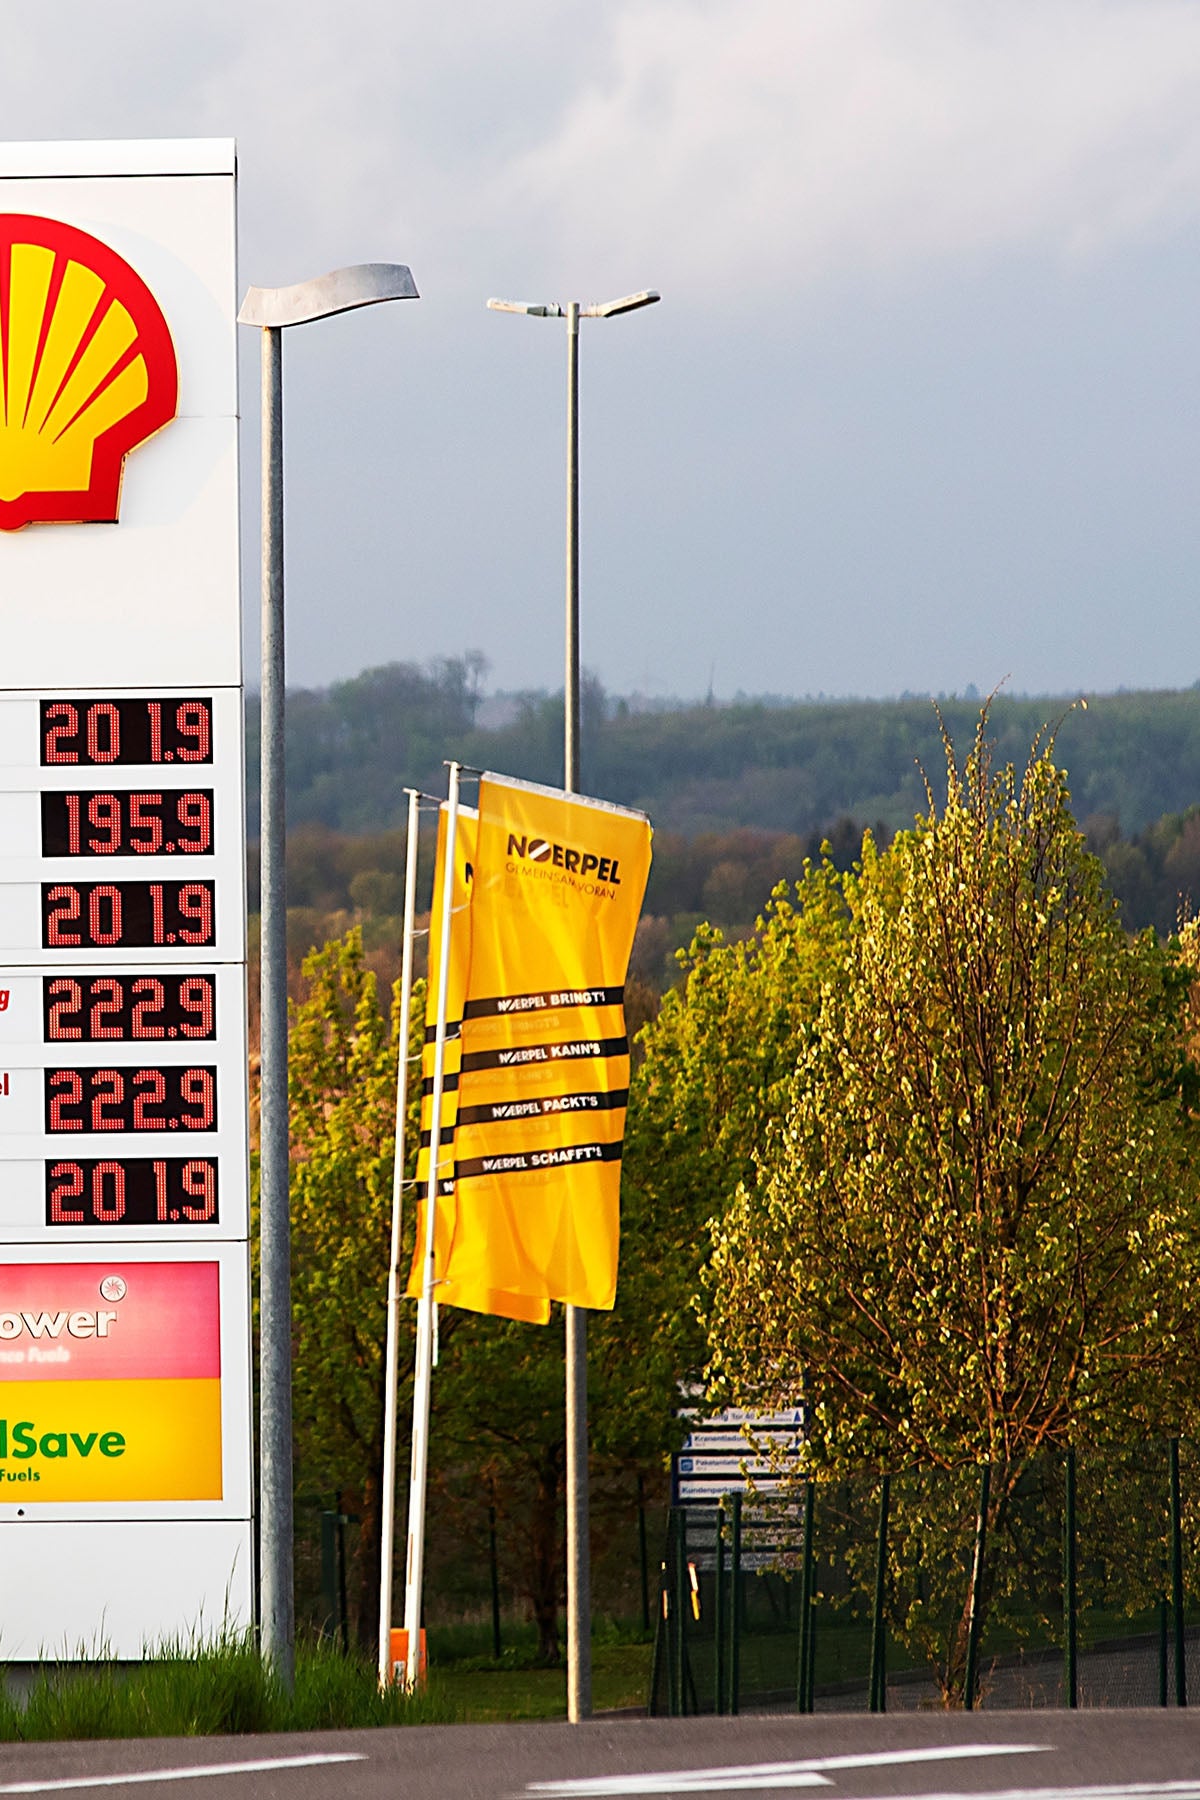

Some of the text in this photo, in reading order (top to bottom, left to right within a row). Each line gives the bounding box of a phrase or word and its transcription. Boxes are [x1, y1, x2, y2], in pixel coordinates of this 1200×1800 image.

[45, 702, 209, 763] 201.9
[65, 793, 211, 854] 195.9
[47, 884, 212, 946] 201.9
[48, 978, 213, 1039] 222.9
[551, 1043, 601, 1058] KANN'S
[49, 1068, 214, 1130] 222.9
[543, 1096, 599, 1112] PACKT'S
[50, 1160, 215, 1222] 201.9
